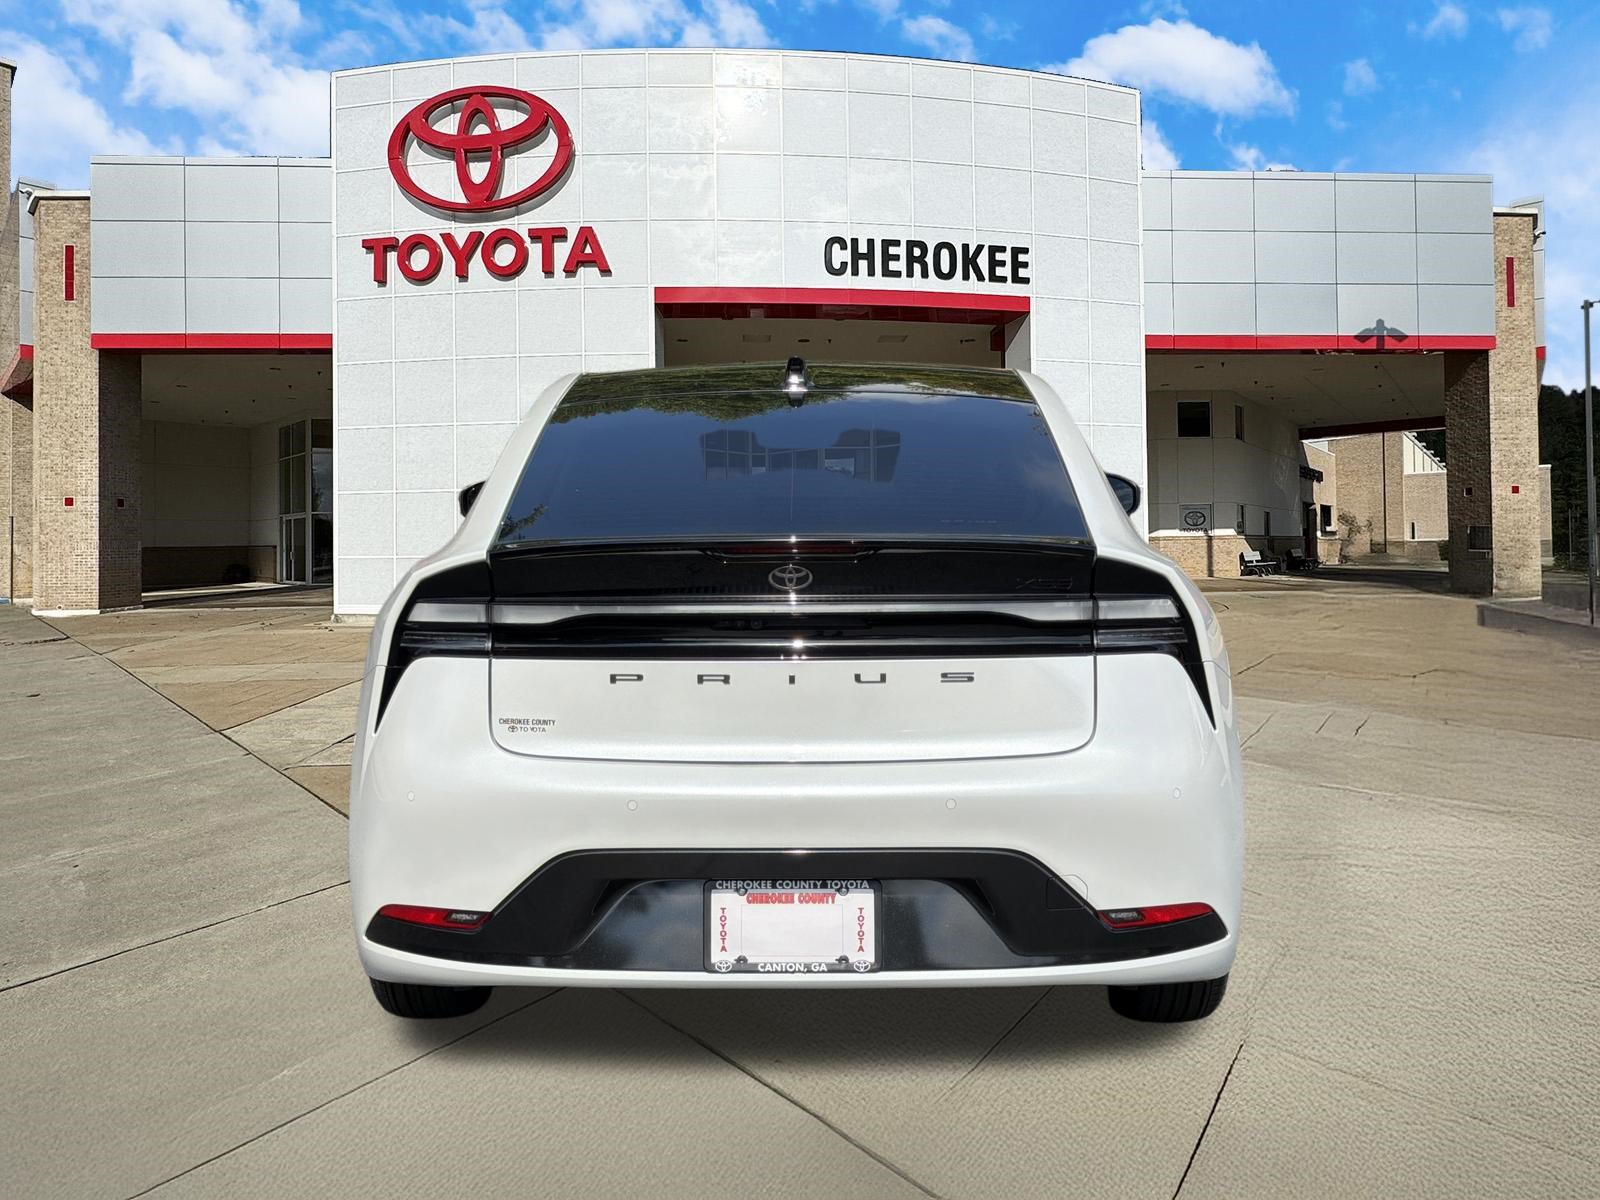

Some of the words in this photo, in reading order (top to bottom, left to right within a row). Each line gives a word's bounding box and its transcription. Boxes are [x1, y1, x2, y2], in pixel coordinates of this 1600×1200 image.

[362, 226, 612, 286] TOYOTA
[825, 236, 1031, 284] CHEROKEE
[610, 671, 975, 686] PRIUS
[716, 880, 772, 889] CHEROKEE
[776, 880, 823, 889] COUNTY
[827, 880, 869, 889] TOYOTA
[746, 893, 795, 904] CHEROKEE
[798, 893, 837, 904] COUNTY
[719, 908, 727, 952] TOYOTA
[857, 908, 865, 952] TOYOTA
[758, 962, 807, 972] CANTON,
[811, 962, 828, 972] GA
